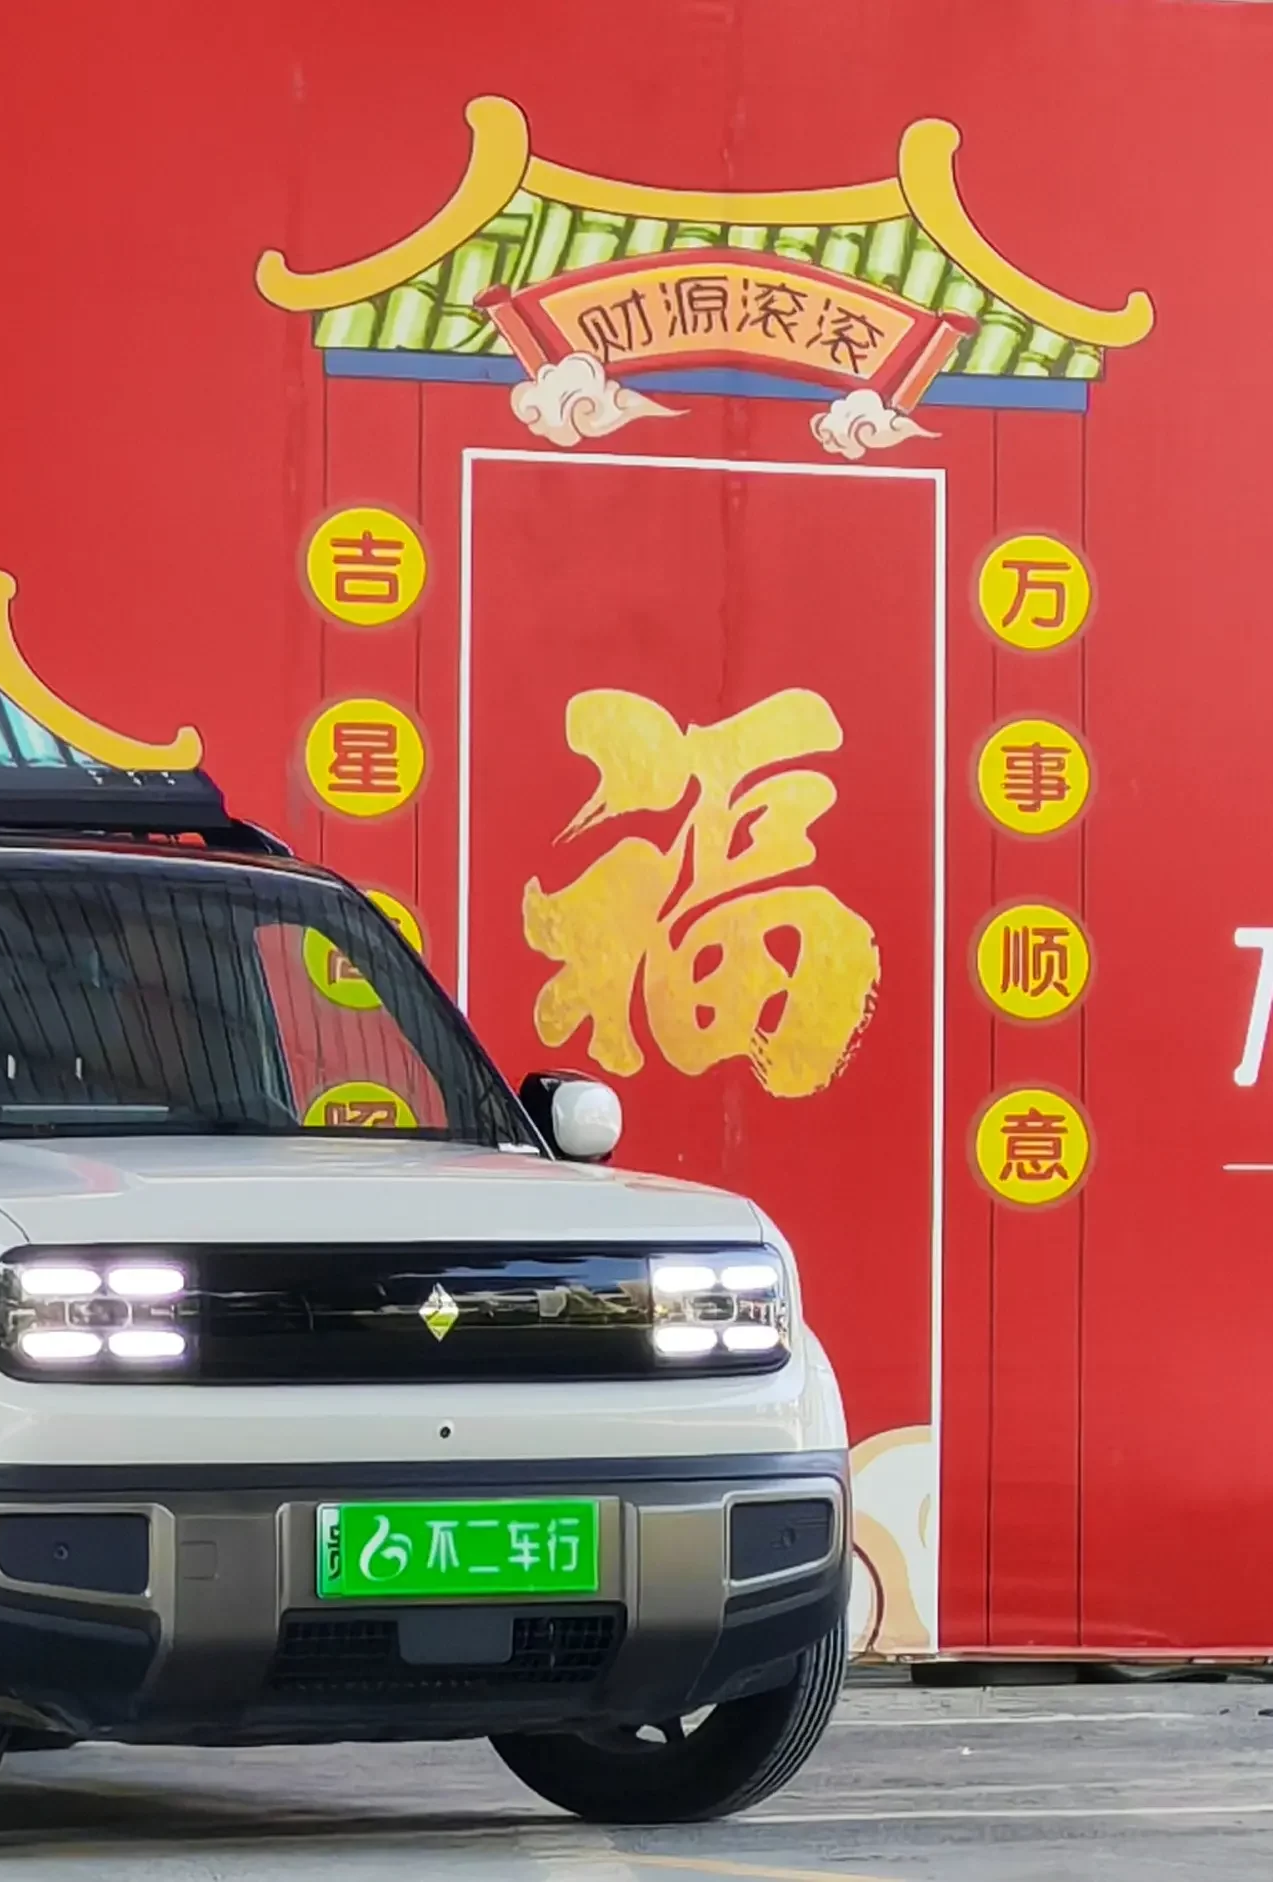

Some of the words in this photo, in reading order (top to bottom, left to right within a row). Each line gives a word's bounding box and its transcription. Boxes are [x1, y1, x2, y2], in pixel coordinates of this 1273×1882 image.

[577, 274, 885, 374] 财源滚滚
[522, 687, 881, 1098] 福
[999, 559, 1072, 1181] 万事顺意
[425, 1517, 580, 1573] 不二车行
